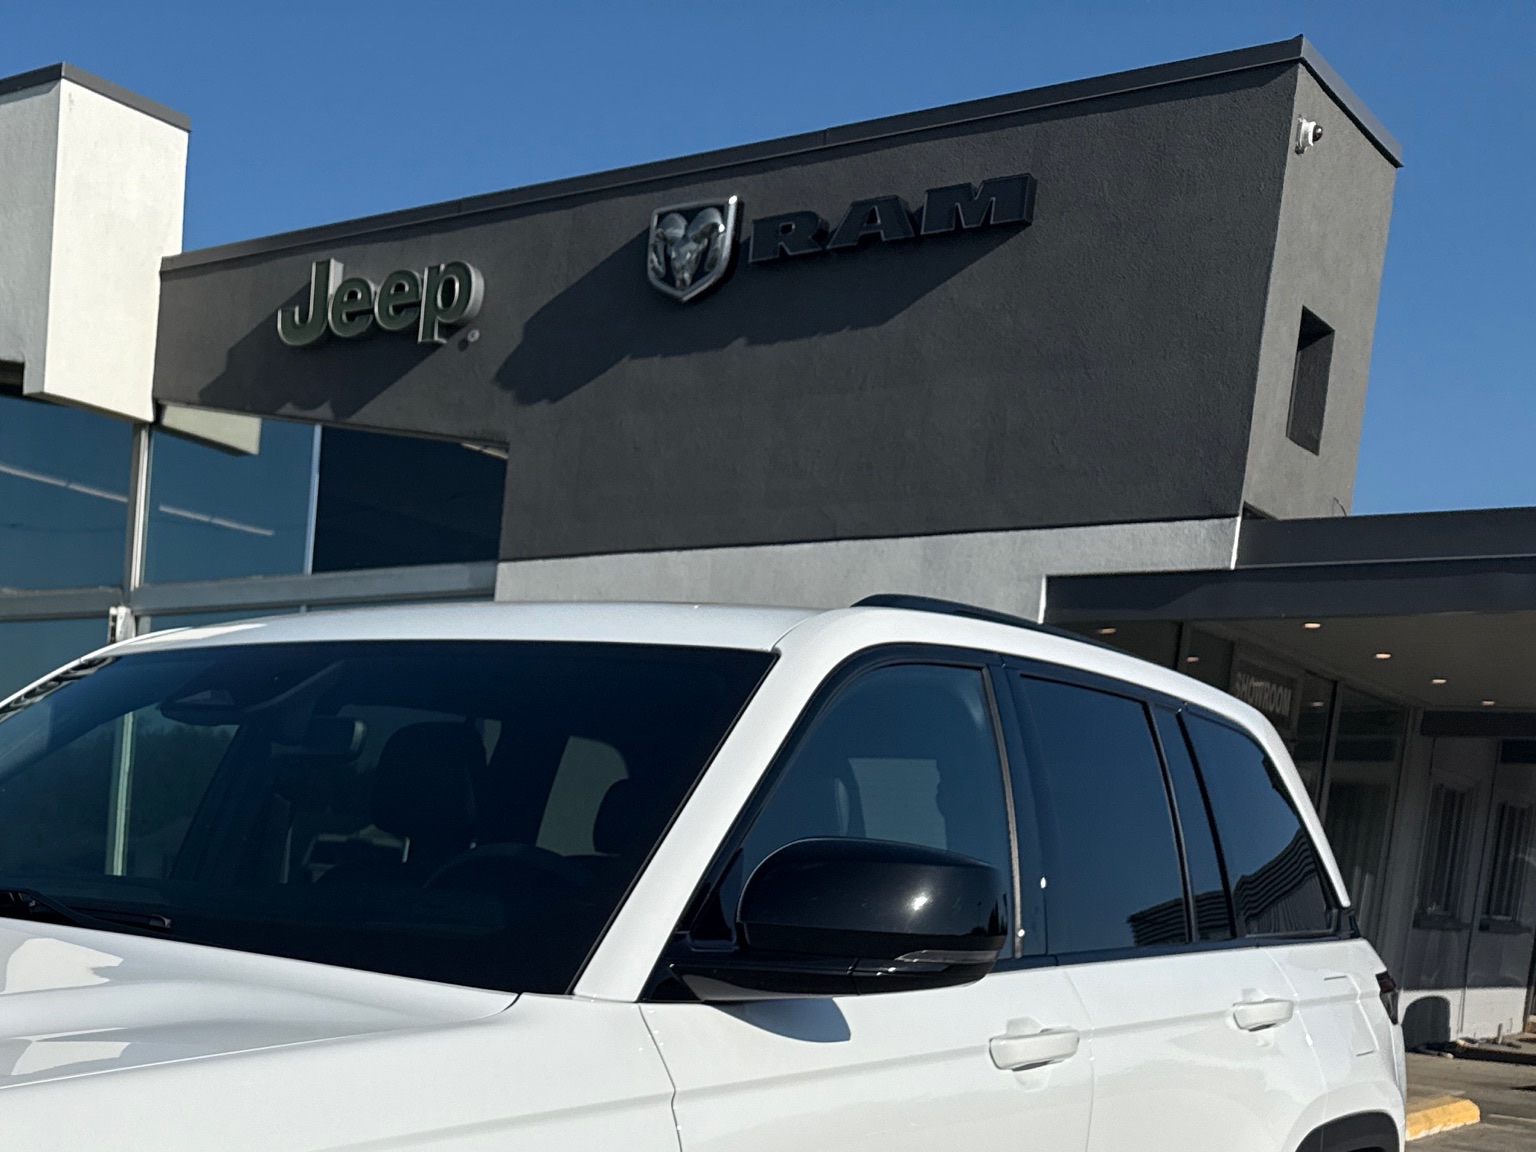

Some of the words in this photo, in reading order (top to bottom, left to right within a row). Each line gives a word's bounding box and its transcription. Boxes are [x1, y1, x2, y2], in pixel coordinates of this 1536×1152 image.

[748, 173, 1038, 263] RAM
[277, 257, 484, 345] Jeep
[1236, 671, 1292, 716] SHOWROOM
